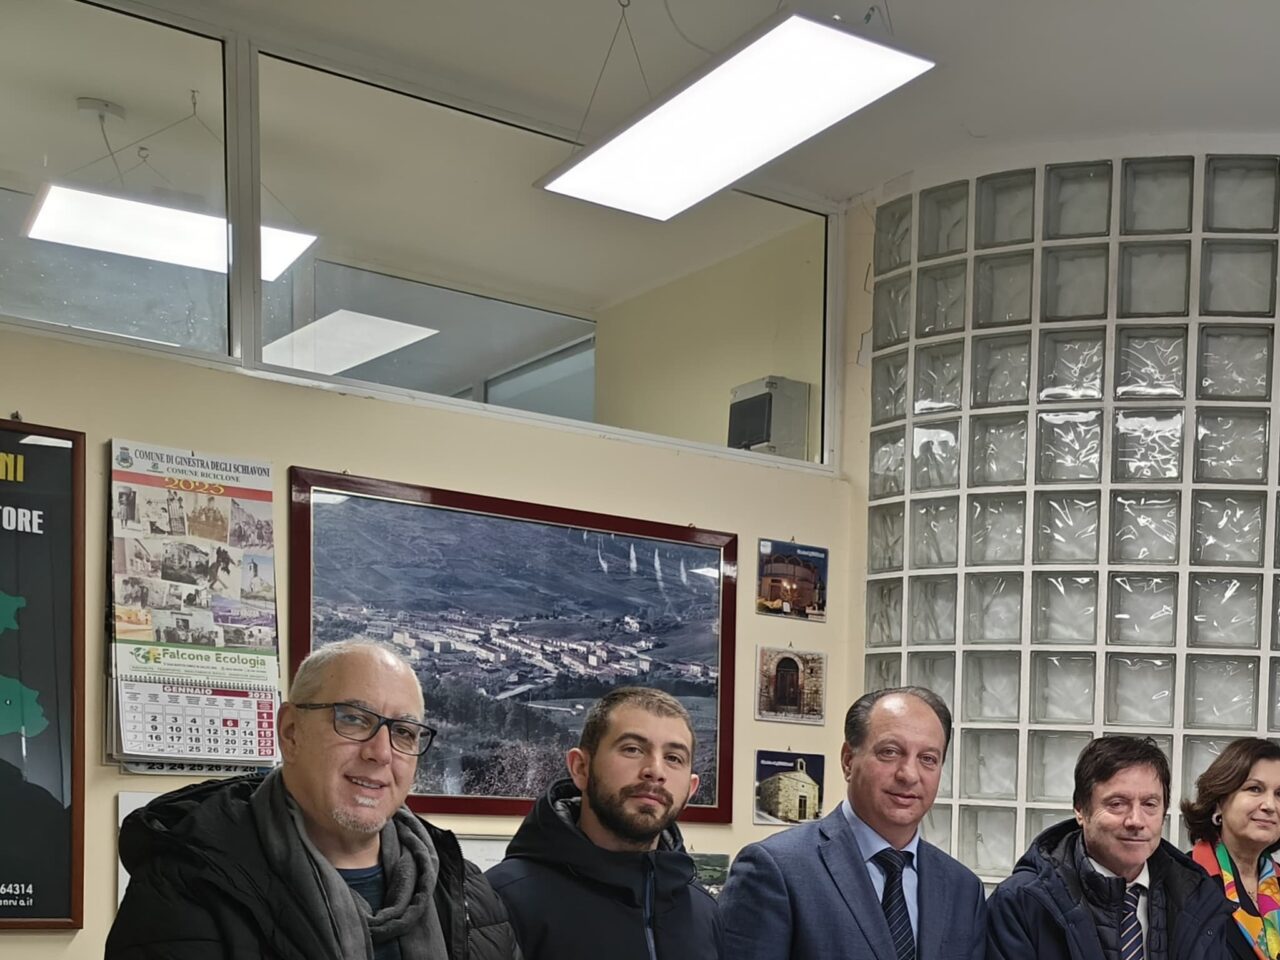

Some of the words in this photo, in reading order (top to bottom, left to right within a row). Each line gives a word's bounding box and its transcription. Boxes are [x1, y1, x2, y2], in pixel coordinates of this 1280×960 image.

[134, 448, 166, 464] COMUNE
[166, 455, 174, 465] DI
[175, 456, 209, 470] GINESTRA
[210, 461, 232, 473] DEGLI
[233, 463, 270, 478] SCHIAVONI
[166, 466, 199, 477] COMUNE
[200, 471, 241, 483] RICICLONE
[0, 505, 44, 535] ORE
[162, 648, 211, 662] Falcone
[215, 653, 266, 669] Ecologia
[164, 686, 213, 695] GENNAIO
[248, 691, 272, 700] 2023
[208, 718, 215, 726] 5
[188, 736, 201, 744] 18
[189, 763, 204, 771] 25
